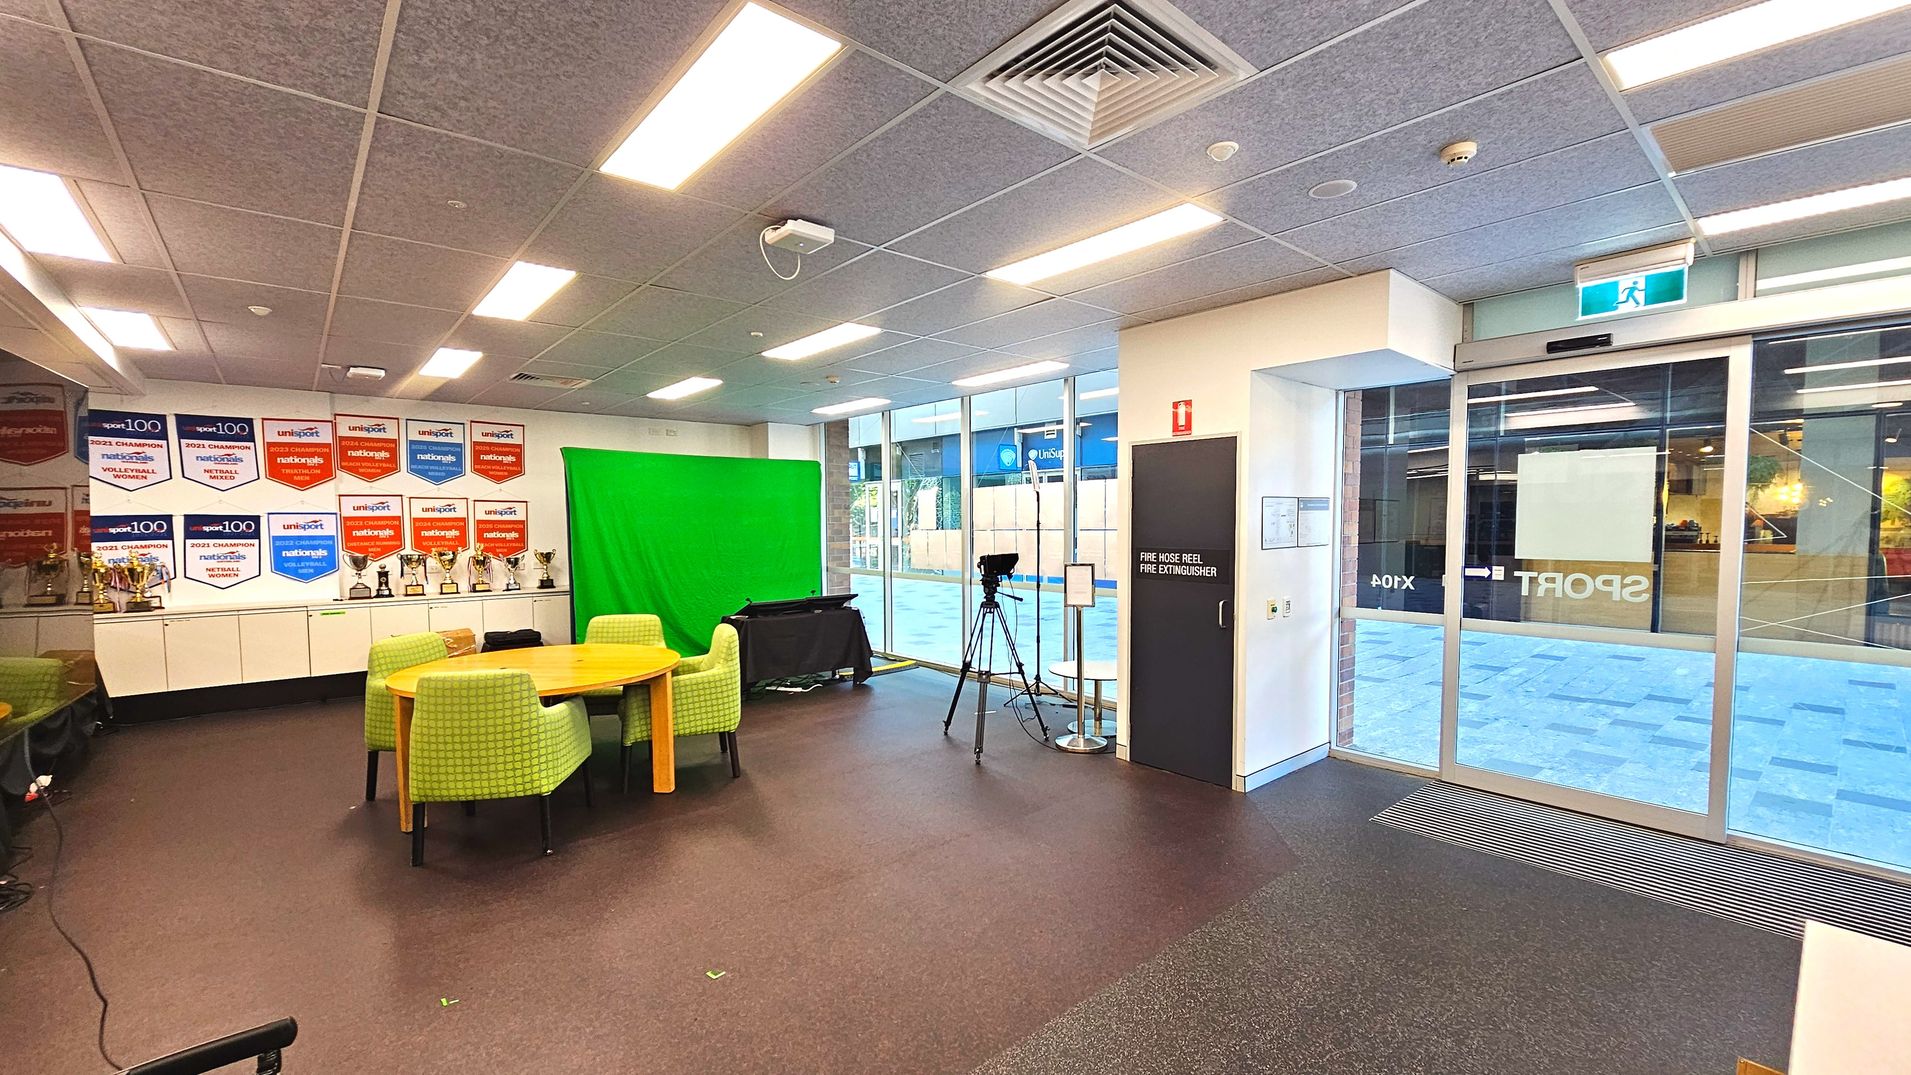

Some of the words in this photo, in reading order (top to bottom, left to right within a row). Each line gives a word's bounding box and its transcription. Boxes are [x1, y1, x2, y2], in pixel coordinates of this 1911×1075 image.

[348, 424, 387, 433] unisport
[277, 429, 320, 438] unisport
[418, 429, 454, 438] unisport
[481, 431, 514, 439] unisport
[101, 452, 154, 461] nationals
[196, 454, 244, 463] nationals
[348, 450, 390, 458] nationals
[417, 453, 456, 461] nationals
[480, 454, 516, 462] nationals
[277, 456, 324, 464] nationals
[352, 504, 391, 512] unisport
[422, 506, 457, 514] unisport
[485, 508, 517, 517] unisport
[282, 522, 324, 531] unisport
[352, 528, 394, 537] nationals
[421, 529, 460, 537] nationals
[199, 553, 247, 561] nationals
[282, 548, 328, 557] nationals
[108, 555, 159, 564] natinals
[1140, 552, 1157, 562] FIRE
[1159, 552, 1180, 563] HOSE
[1182, 553, 1203, 564] REEL
[1140, 563, 1157, 574] FIRE
[1159, 564, 1217, 577] EXTINGUISHER
